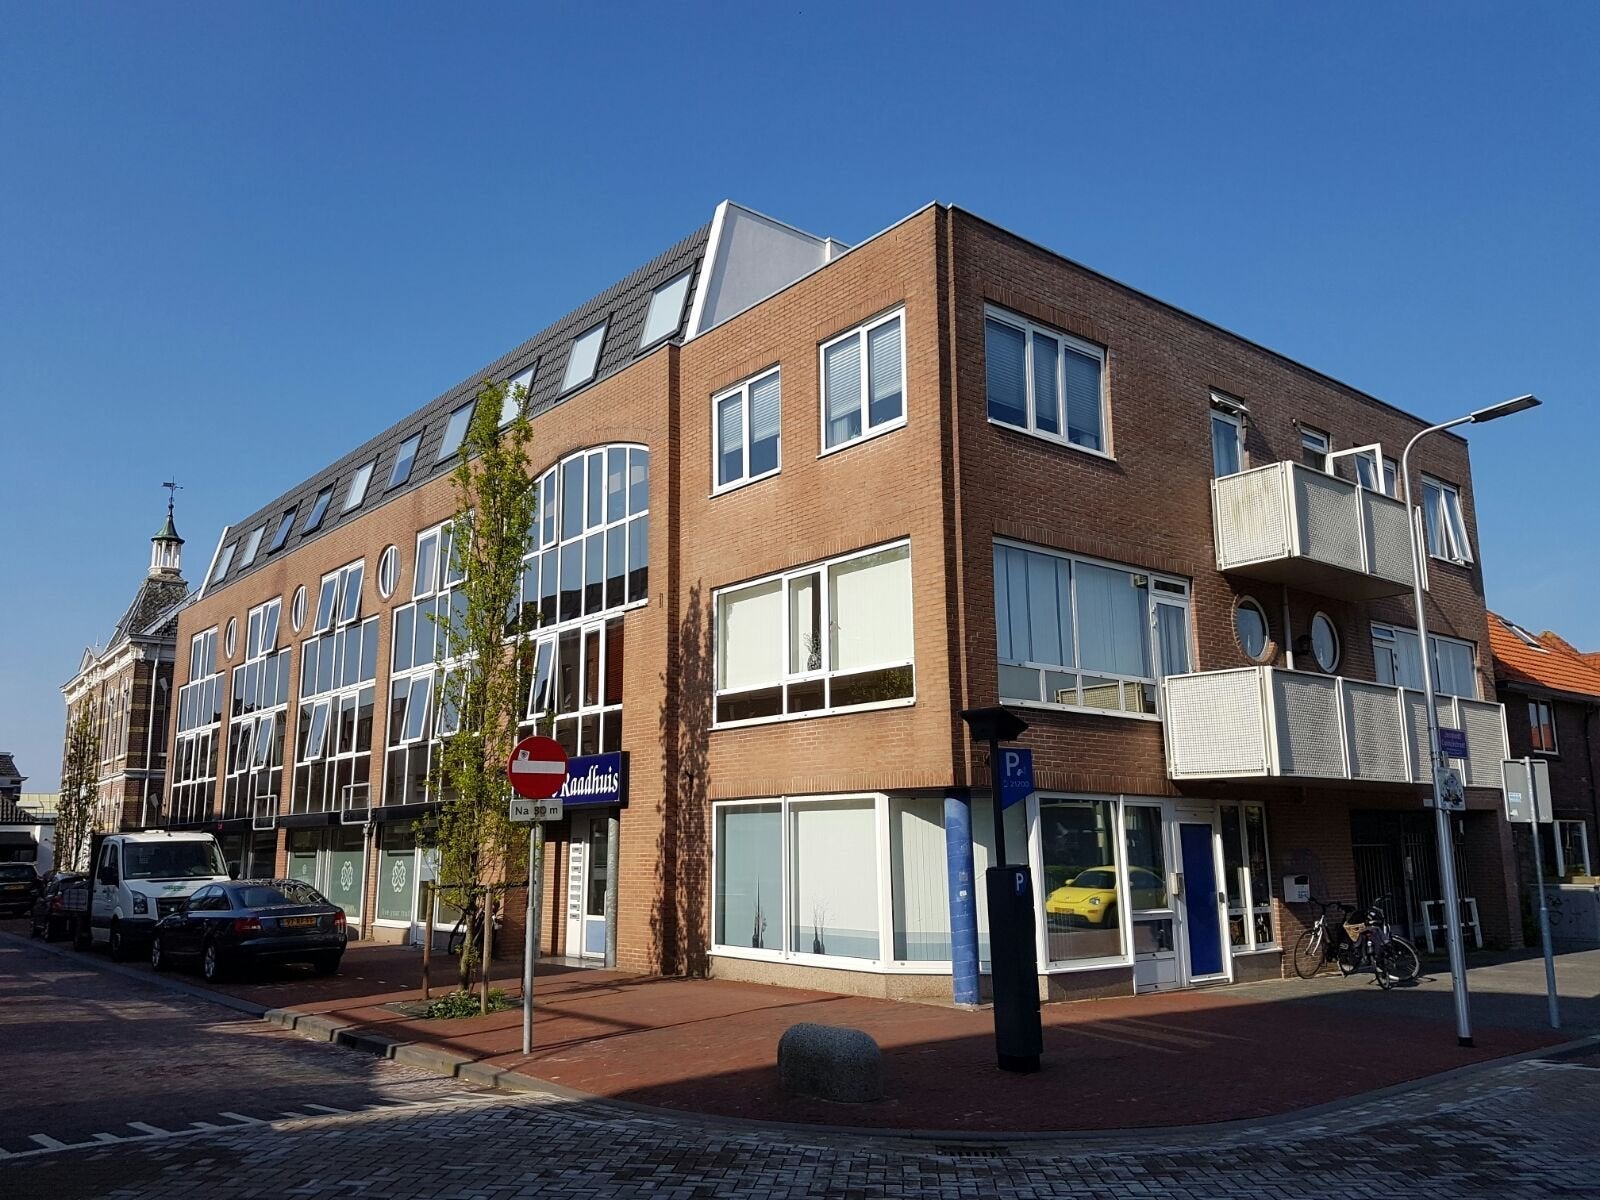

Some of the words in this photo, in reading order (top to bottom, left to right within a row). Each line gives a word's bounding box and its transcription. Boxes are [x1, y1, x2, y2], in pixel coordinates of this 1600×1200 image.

[1006, 751, 1020, 777] P
[559, 764, 619, 798] Raadhuis
[515, 806, 529, 815] Na
[550, 807, 558, 815] m
[1015, 872, 1024, 891] P
